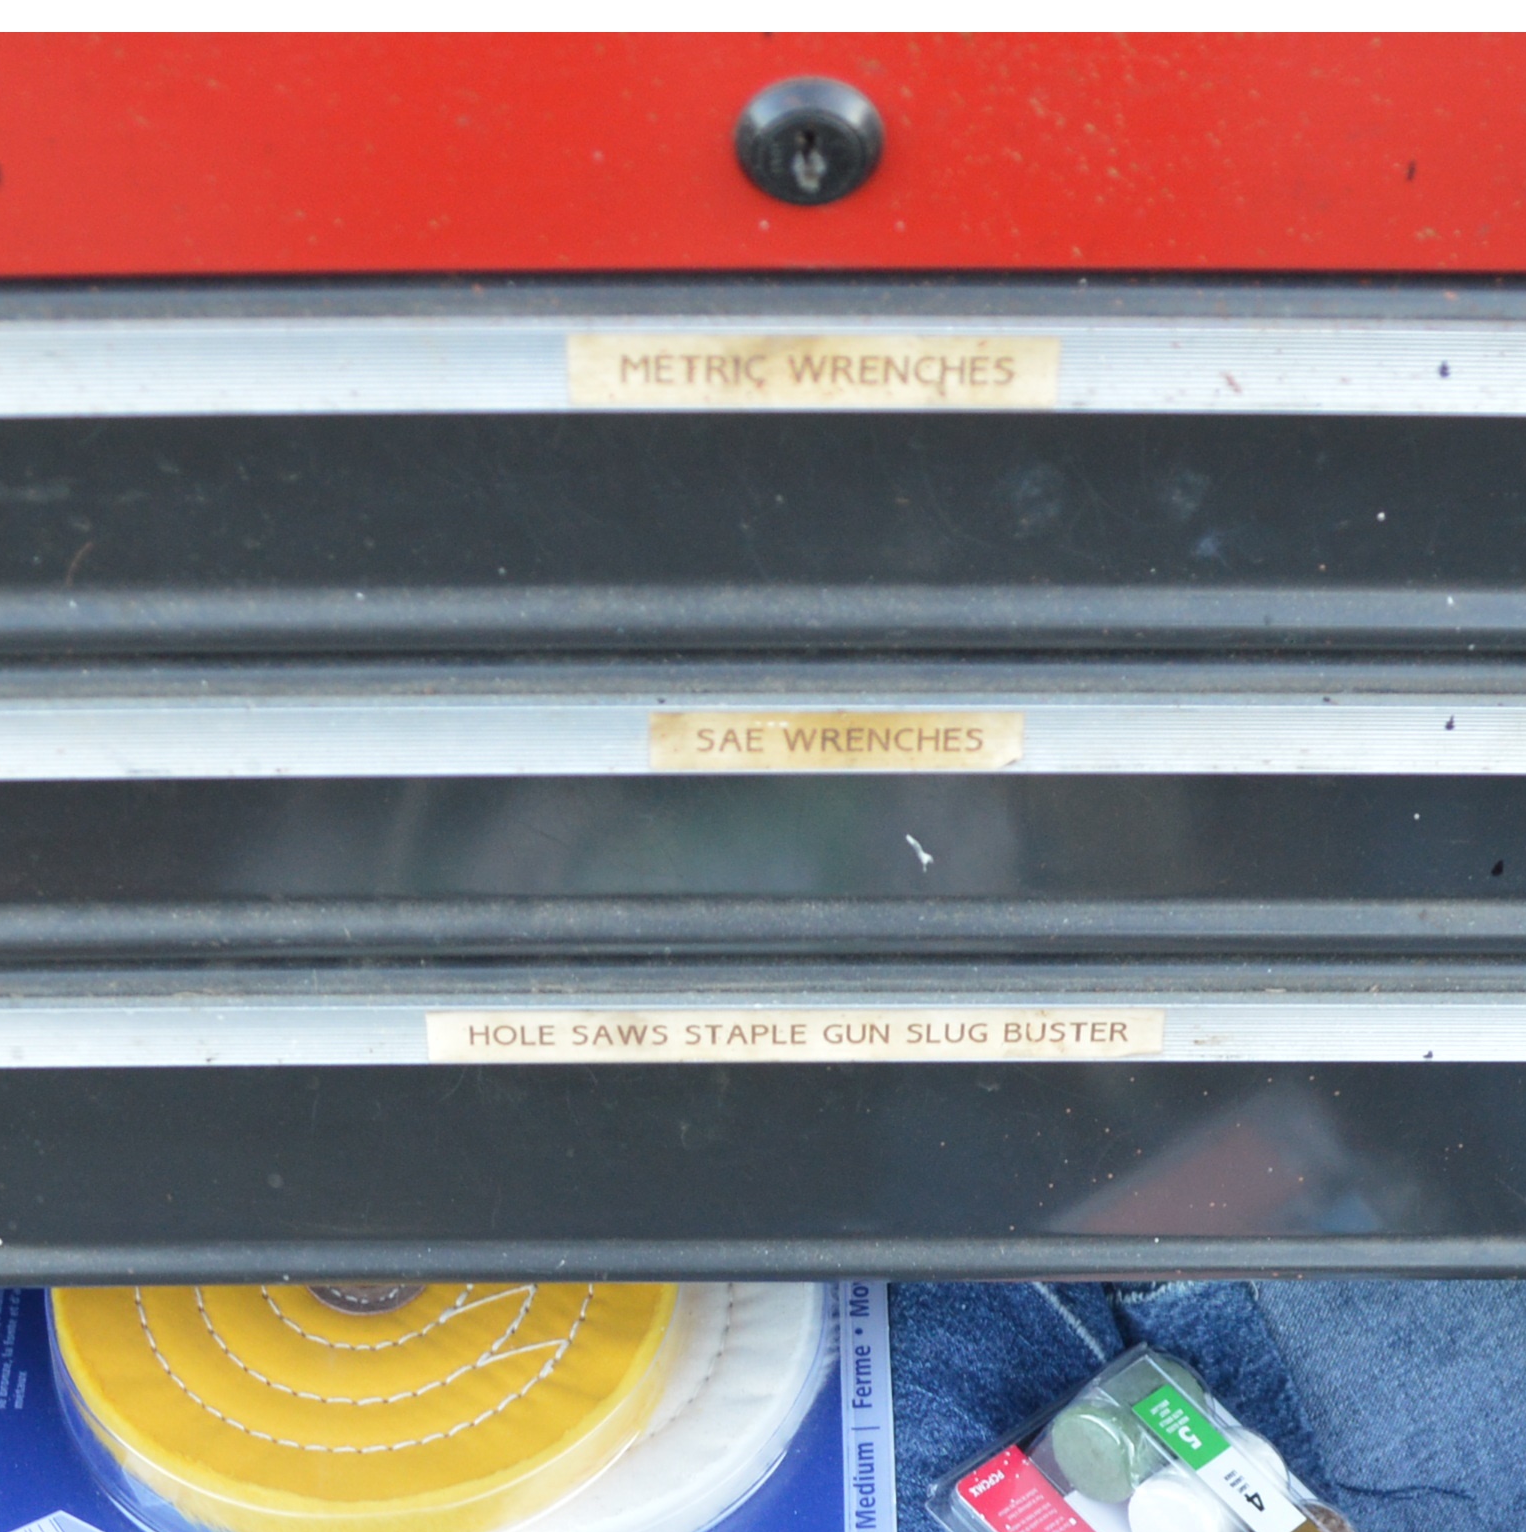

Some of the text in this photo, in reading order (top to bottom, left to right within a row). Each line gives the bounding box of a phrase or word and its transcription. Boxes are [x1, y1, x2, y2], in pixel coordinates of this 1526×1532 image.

[619, 354, 1016, 388] METRIC WRENCHES
[695, 727, 985, 753] SAE WRENCHES
[468, 1021, 1129, 1047] HOLE SAWS STAPLE GUN SLUG BUSTER
[849, 1282, 870, 1317] Mo
[852, 1344, 872, 1409] Ferme
[1178, 1426, 1202, 1449] 5
[853, 1441, 877, 1530] Medium
[1244, 1493, 1264, 1511] 4
